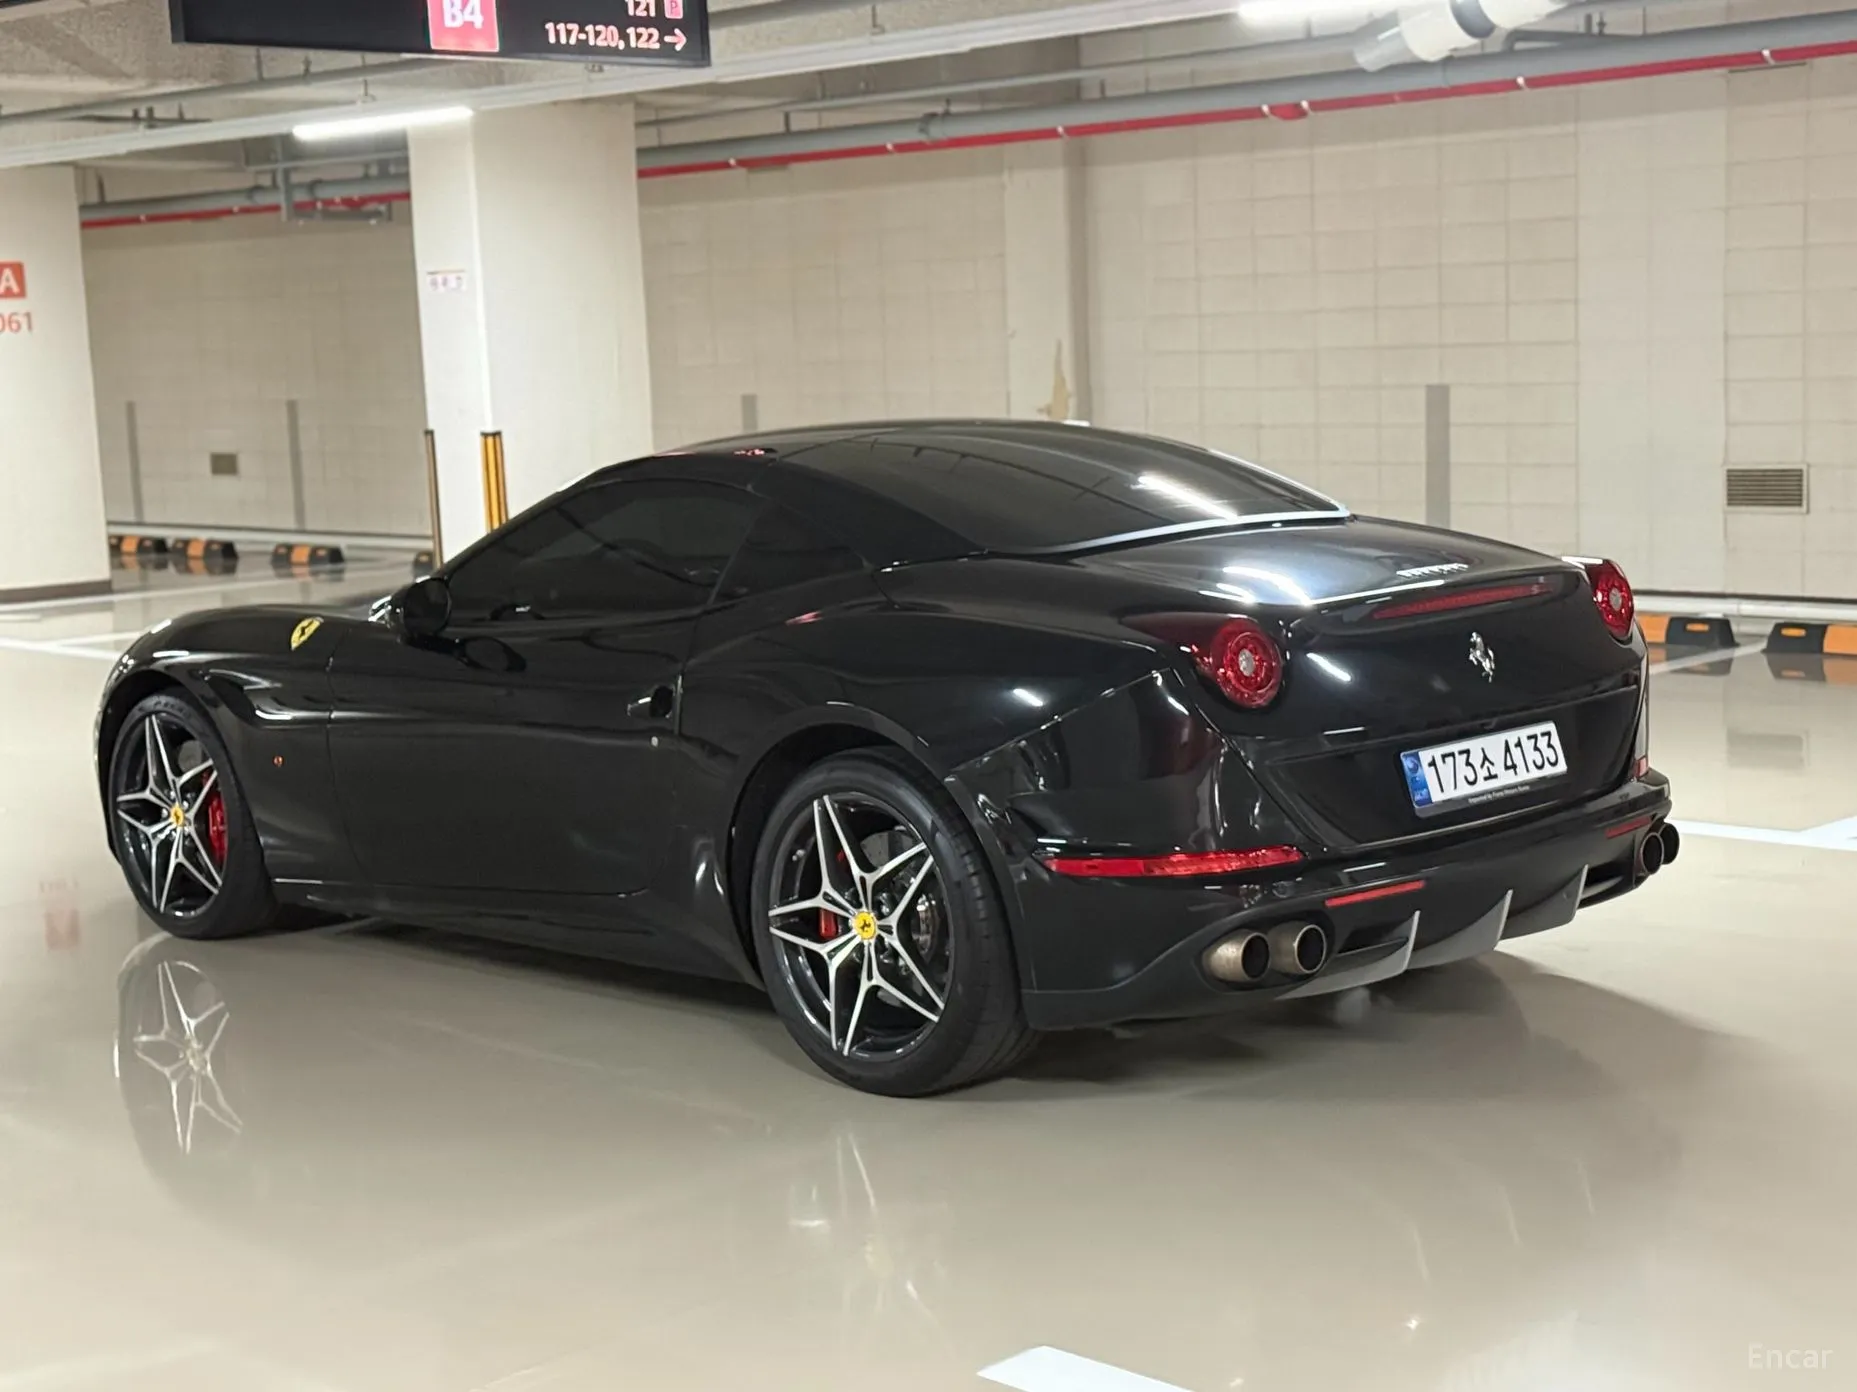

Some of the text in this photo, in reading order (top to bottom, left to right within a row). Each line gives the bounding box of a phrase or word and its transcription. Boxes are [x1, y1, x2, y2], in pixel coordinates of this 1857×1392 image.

[442, 0, 484, 29] B4
[625, 0, 656, 17] 121
[0, 267, 20, 295] A
[1428, 731, 1558, 793] 173소 4133
